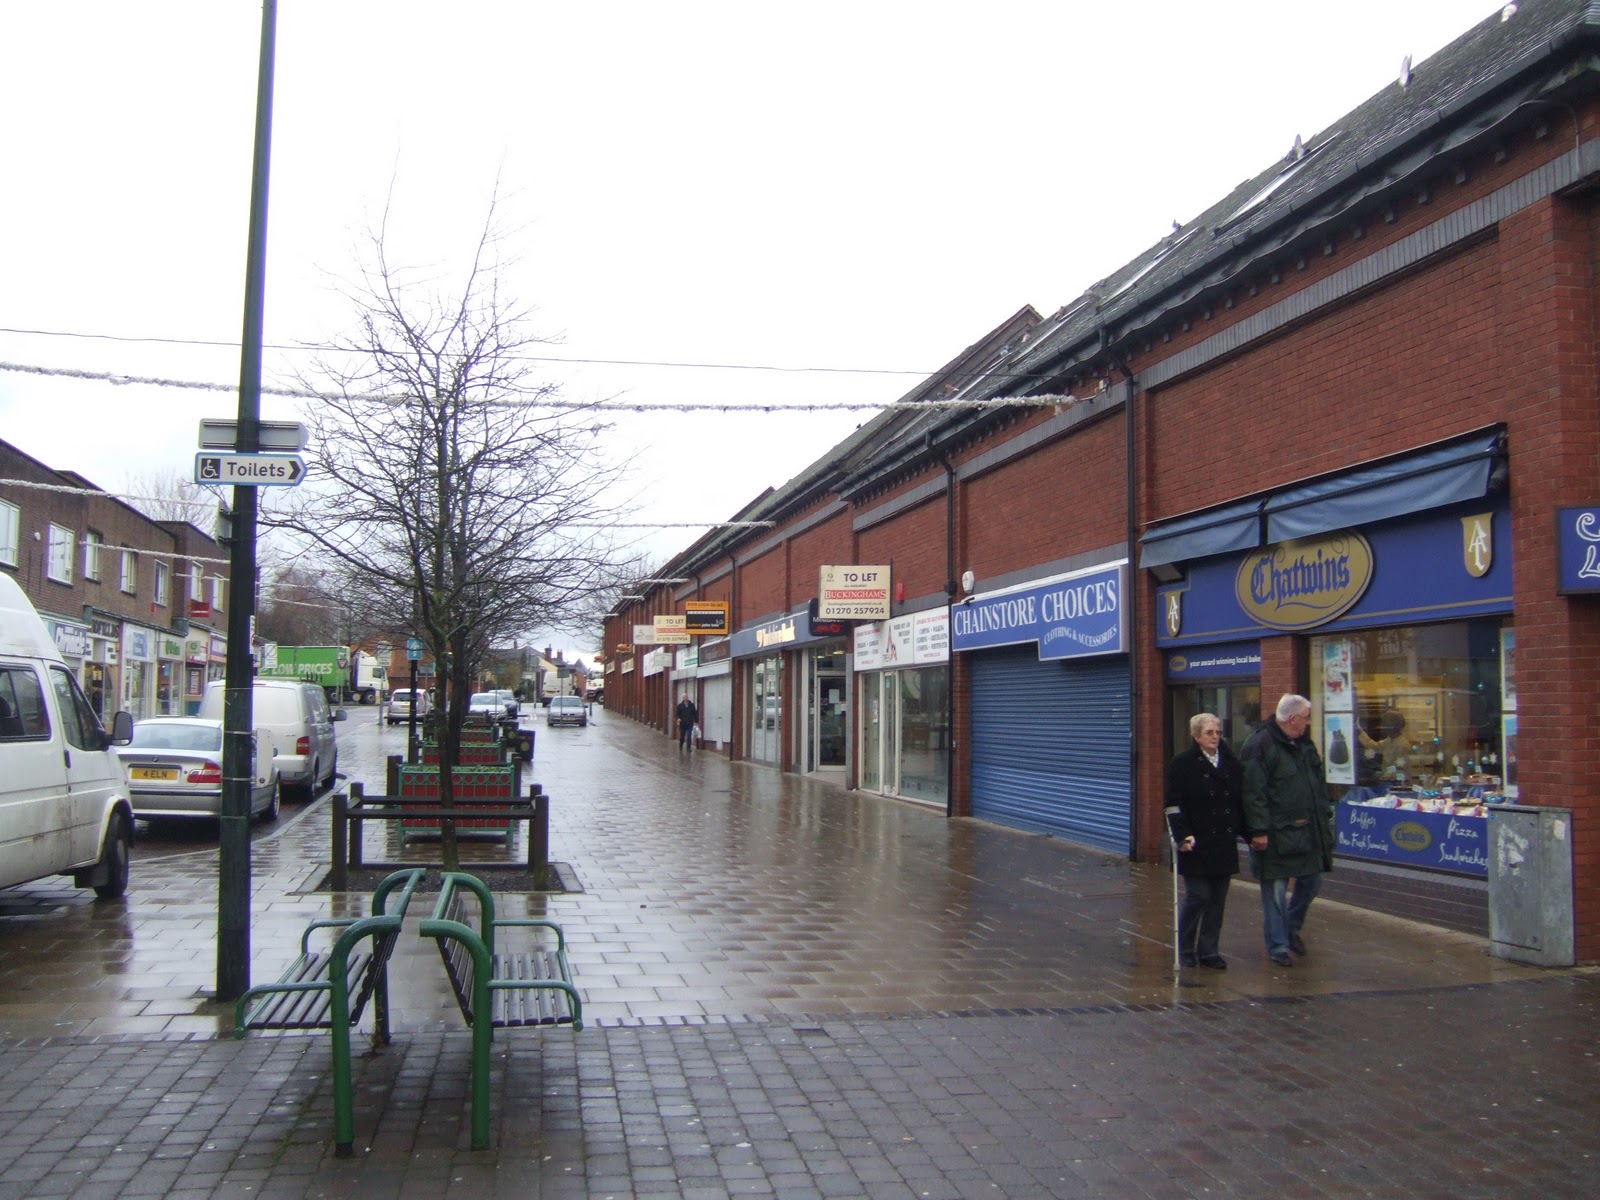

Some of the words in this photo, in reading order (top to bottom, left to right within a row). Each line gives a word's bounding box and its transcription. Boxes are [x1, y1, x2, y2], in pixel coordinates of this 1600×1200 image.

[227, 462, 285, 476] Toilets
[844, 573, 858, 582] TO
[862, 573, 878, 582] LET
[1250, 547, 1350, 611] Chatwins
[825, 589, 886, 600] BUCKINGHAMS
[826, 607, 851, 615] 01270
[854, 607, 884, 615] 257924
[954, 595, 1037, 636] CHAINSTORE
[1041, 579, 1117, 623] CHOICES
[1044, 626, 1072, 645] CLOTHING
[1072, 629, 1077, 641] &
[1078, 624, 1117, 647] ACCESSORIES
[1201, 658, 1216, 666] award
[1216, 657, 1235, 665] winning
[271, 663, 295, 675] LOW
[298, 663, 333, 675] PRICES
[150, 770, 167, 778] ELN
[1447, 817, 1478, 839] Pizza
[1438, 843, 1489, 870] Sandwiches
